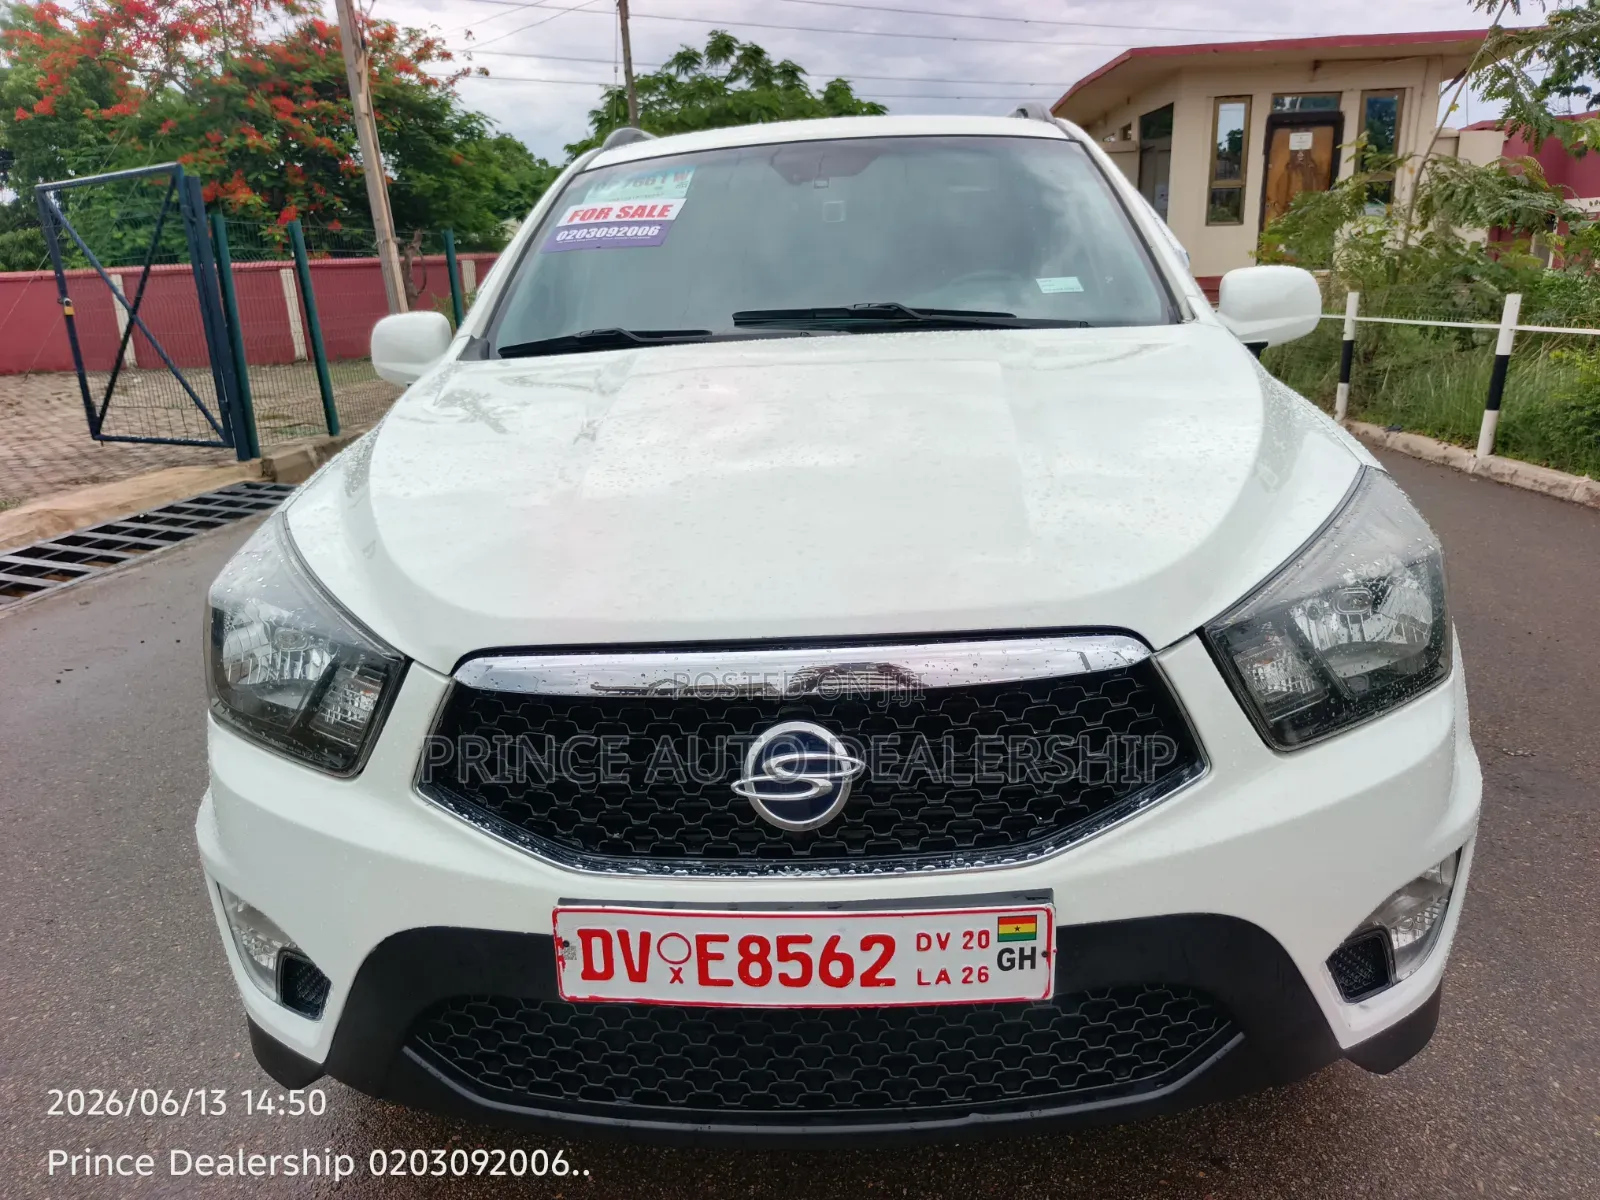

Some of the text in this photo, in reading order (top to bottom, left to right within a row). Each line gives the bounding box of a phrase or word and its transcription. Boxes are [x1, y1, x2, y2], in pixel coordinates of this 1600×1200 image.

[568, 204, 674, 223] FOR SALE
[556, 226, 661, 241] 0203092006
[916, 928, 991, 953] DV 20
[577, 928, 653, 983] DV
[697, 933, 897, 988] E8562
[996, 946, 1037, 972] GH
[916, 965, 991, 987] LA 26
